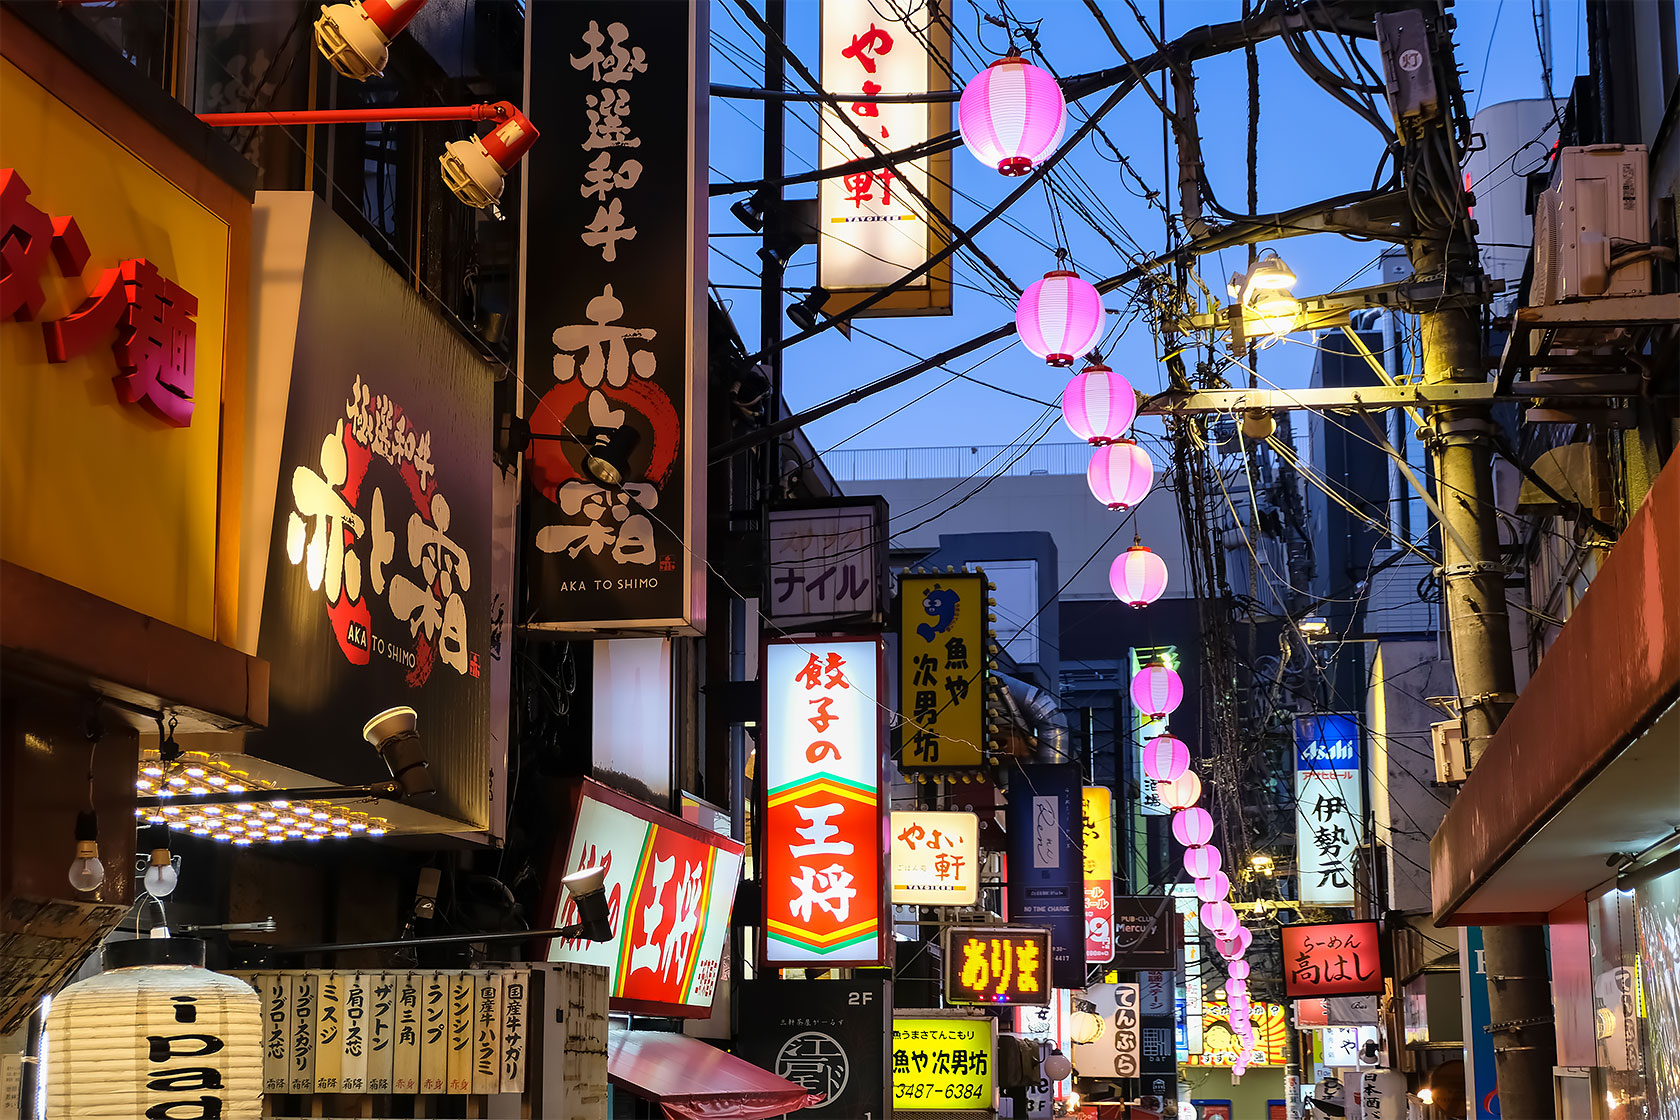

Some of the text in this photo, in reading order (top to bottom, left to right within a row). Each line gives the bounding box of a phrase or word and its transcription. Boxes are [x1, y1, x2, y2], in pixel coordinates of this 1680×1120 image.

[560, 577, 658, 592] AKA TO SHIMO
[774, 564, 870, 603] ナイル
[347, 622, 418, 670] AKA TO SHIMO
[944, 637, 969, 706] 魚や
[795, 652, 850, 764] 餃子の
[913, 653, 940, 763] 次男坊
[1301, 740, 1354, 761] Asahi
[789, 803, 857, 923] 王将
[897, 822, 963, 850] やよい
[1312, 793, 1350, 888] 伊勢元
[935, 853, 965, 881] 軒
[629, 852, 703, 985] 王将
[1116, 923, 1157, 935] Mercuy
[1304, 934, 1361, 953] らーめん
[961, 938, 1039, 994] ありま
[1292, 952, 1375, 984] 高はし
[268, 985, 287, 1059] リブロース芯
[295, 984, 314, 1071] リブロースカブリ
[320, 984, 339, 1044] ミスジ
[345, 983, 363, 1057] 肩ロース芯
[373, 984, 393, 1051] ザブトン
[399, 983, 417, 1046] 肩三角
[427, 984, 445, 1044] ランプ
[453, 984, 470, 1051] シンシン
[848, 992, 873, 1005] 2F
[479, 986, 496, 1076] 国産牛ハラミ
[505, 983, 523, 1080] 国産牛サガリ
[893, 1030, 975, 1040] 魚うまさてんこもり
[893, 1049, 988, 1076] 魚や次男坊
